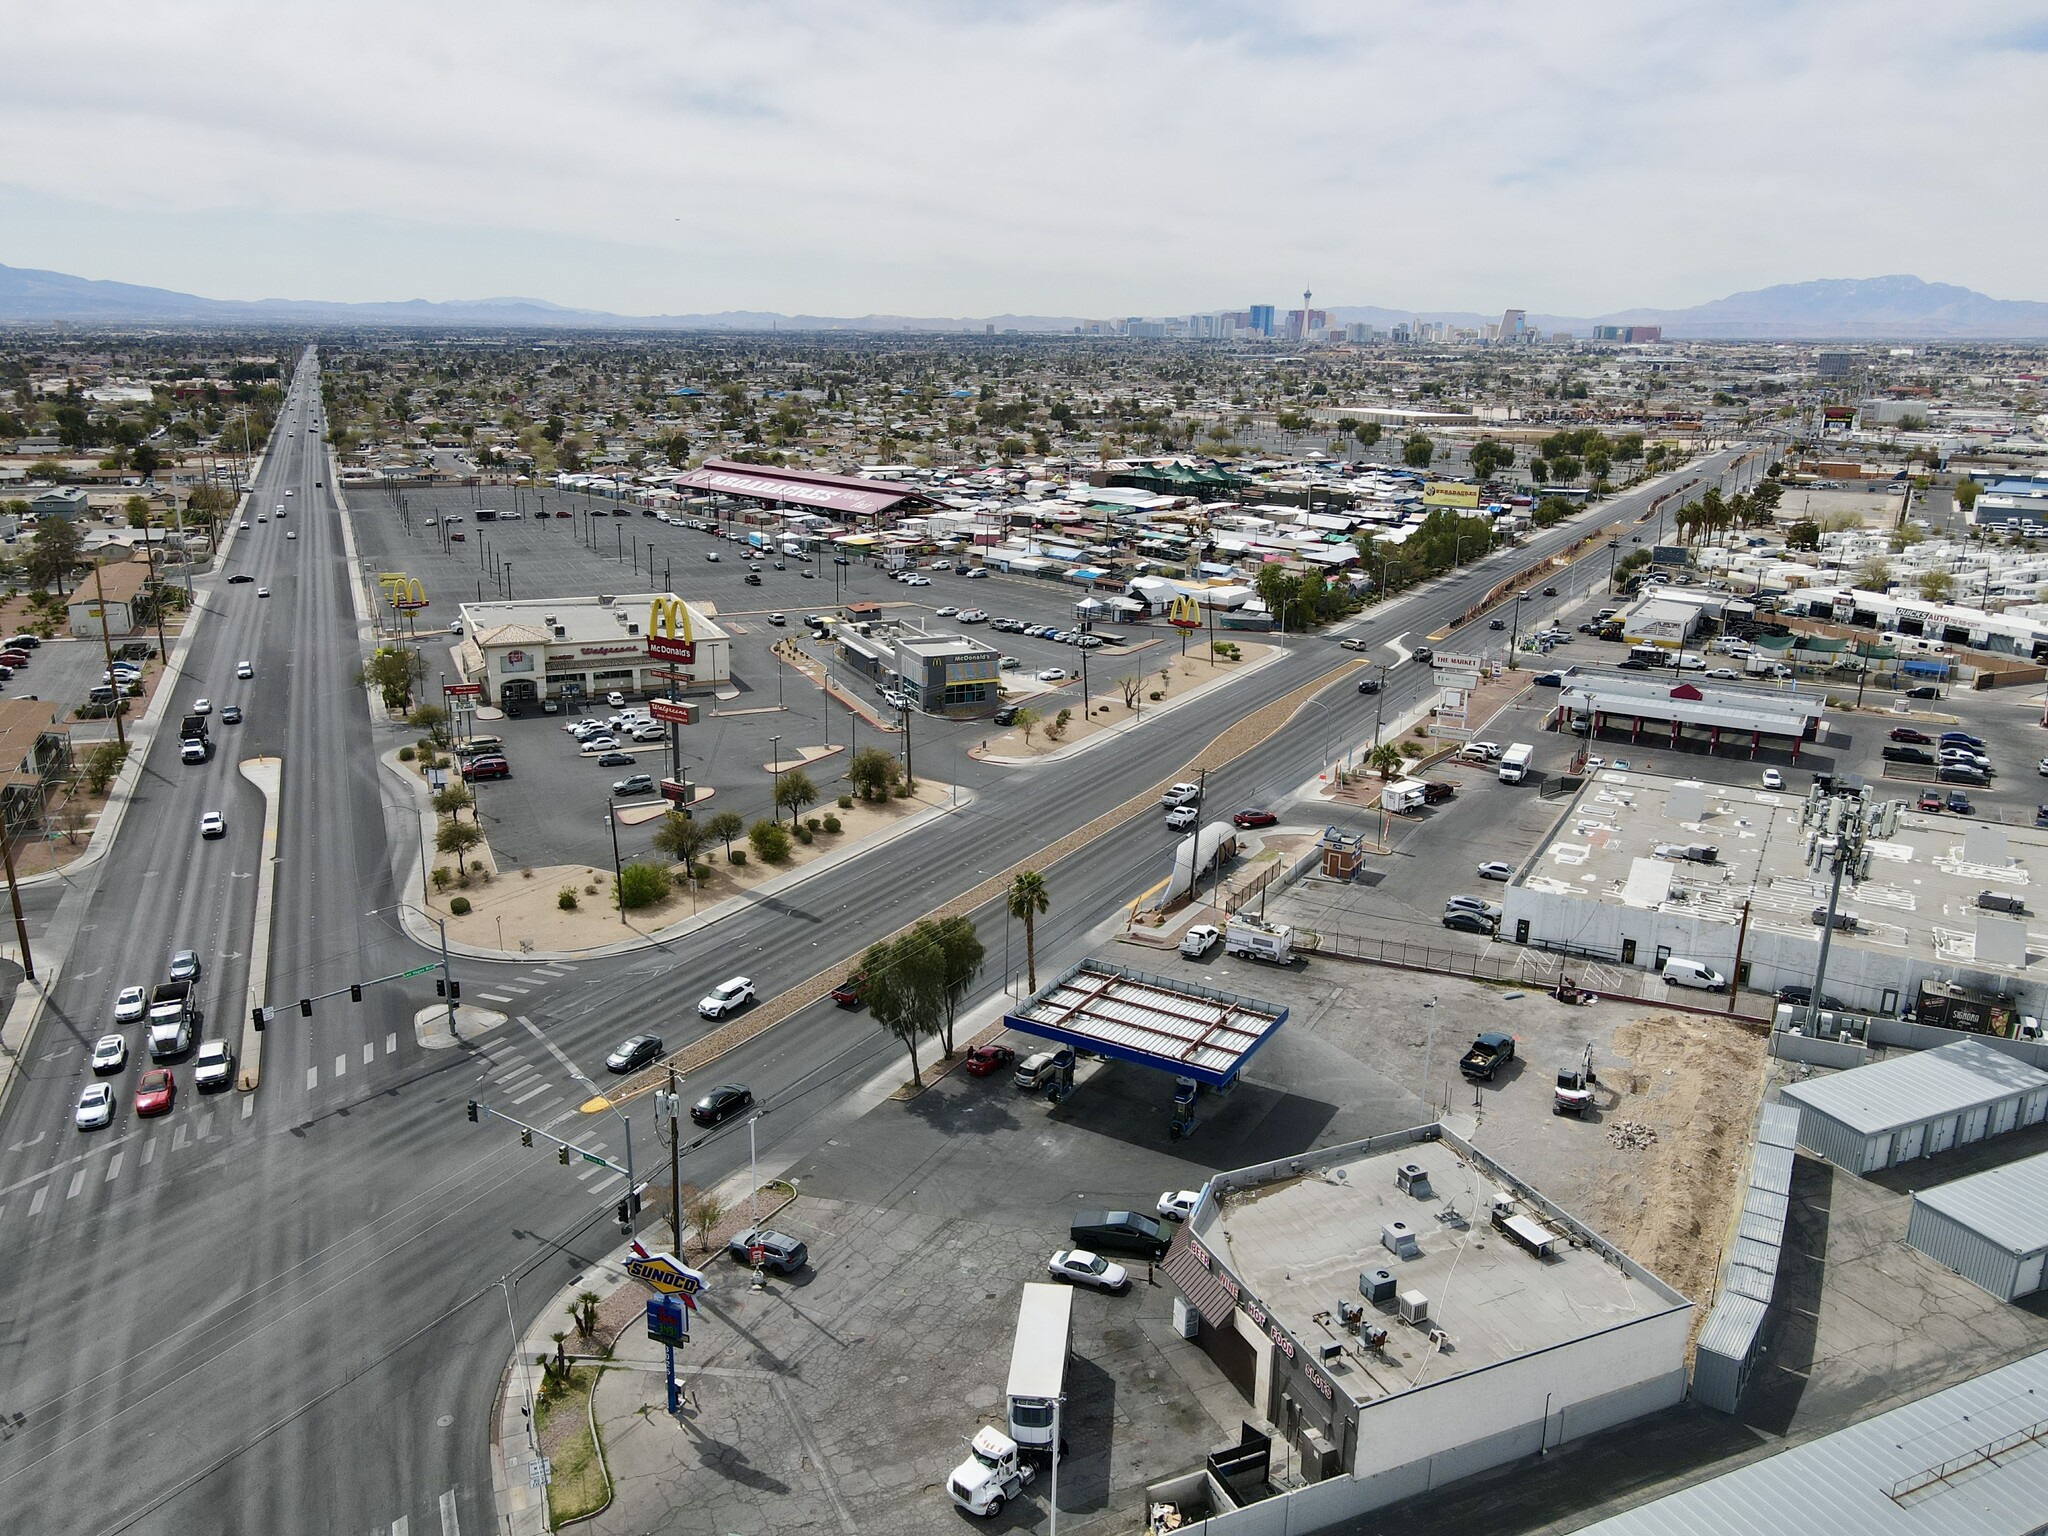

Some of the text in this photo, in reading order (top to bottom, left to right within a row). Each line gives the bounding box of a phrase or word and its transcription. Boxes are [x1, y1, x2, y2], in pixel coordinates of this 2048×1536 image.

[710, 474, 841, 501] BROADACRES
[1896, 608, 1928, 619] QUICKS
[1928, 613, 1950, 623] AUTO
[580, 645, 639, 656] Walgreens
[650, 644, 691, 658] McDonald's
[954, 654, 990, 662] McDonald's
[1451, 658, 1477, 666] MARKET
[651, 703, 688, 716] Walgreens
[631, 1262, 696, 1292] SUNOCO
[1191, 1240, 1332, 1400] BEER WINE HOT FOOD SLOTS
